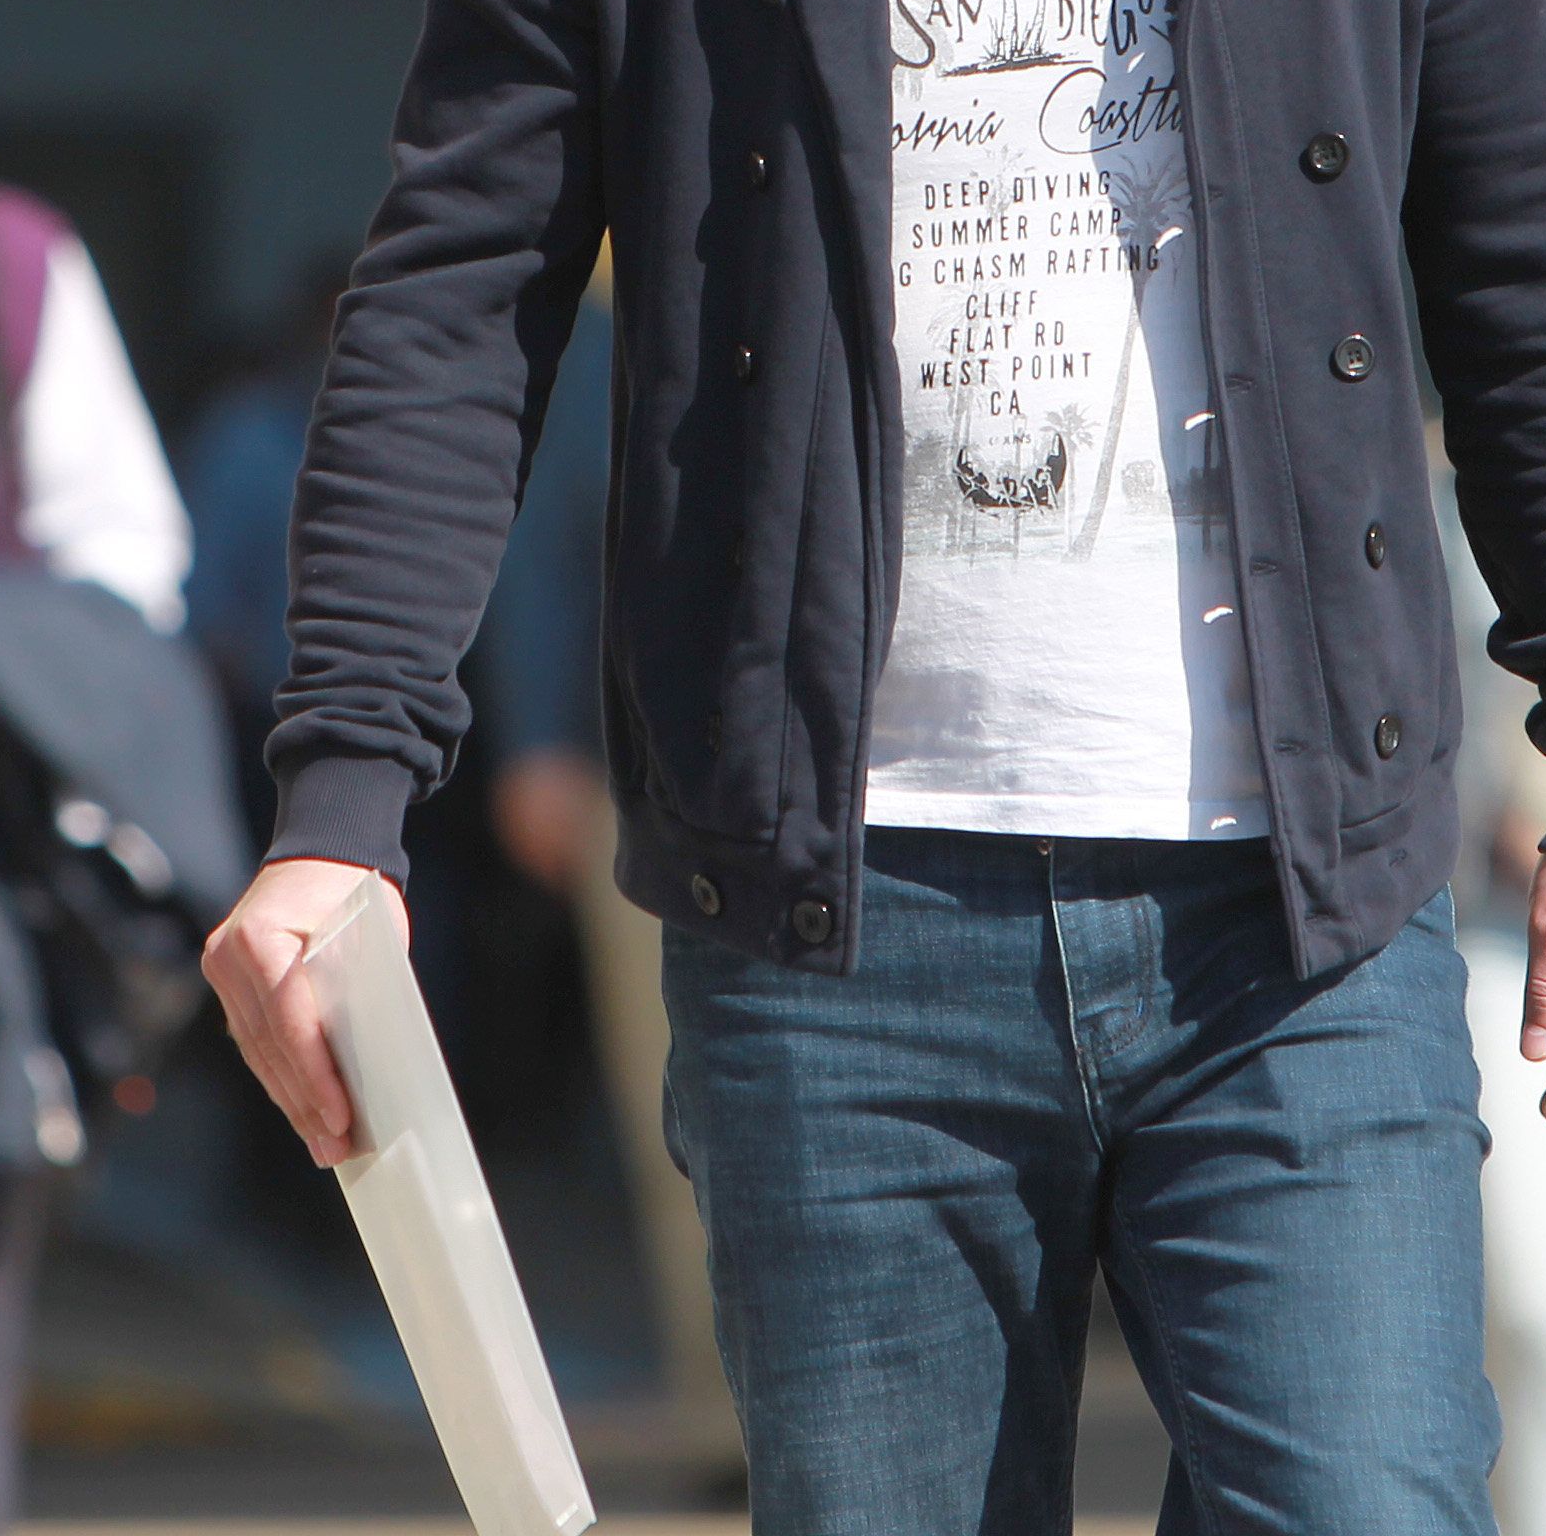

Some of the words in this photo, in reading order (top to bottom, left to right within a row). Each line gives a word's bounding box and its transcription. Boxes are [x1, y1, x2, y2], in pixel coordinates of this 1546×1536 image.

[925, 180, 989, 209] DEEP
[1013, 171, 1110, 202] DIVING
[912, 215, 1028, 249] SUMMER
[1051, 207, 1121, 237] CAMP
[934, 252, 1026, 284] CHASM
[1047, 245, 1159, 275] RAFTING
[966, 290, 1037, 320] CLIFF
[950, 325, 1012, 354] FLAT
[1035, 321, 1064, 346] RD
[921, 359, 989, 389] WEST
[1012, 352, 1091, 381] POINT
[990, 390, 1021, 416] CA
